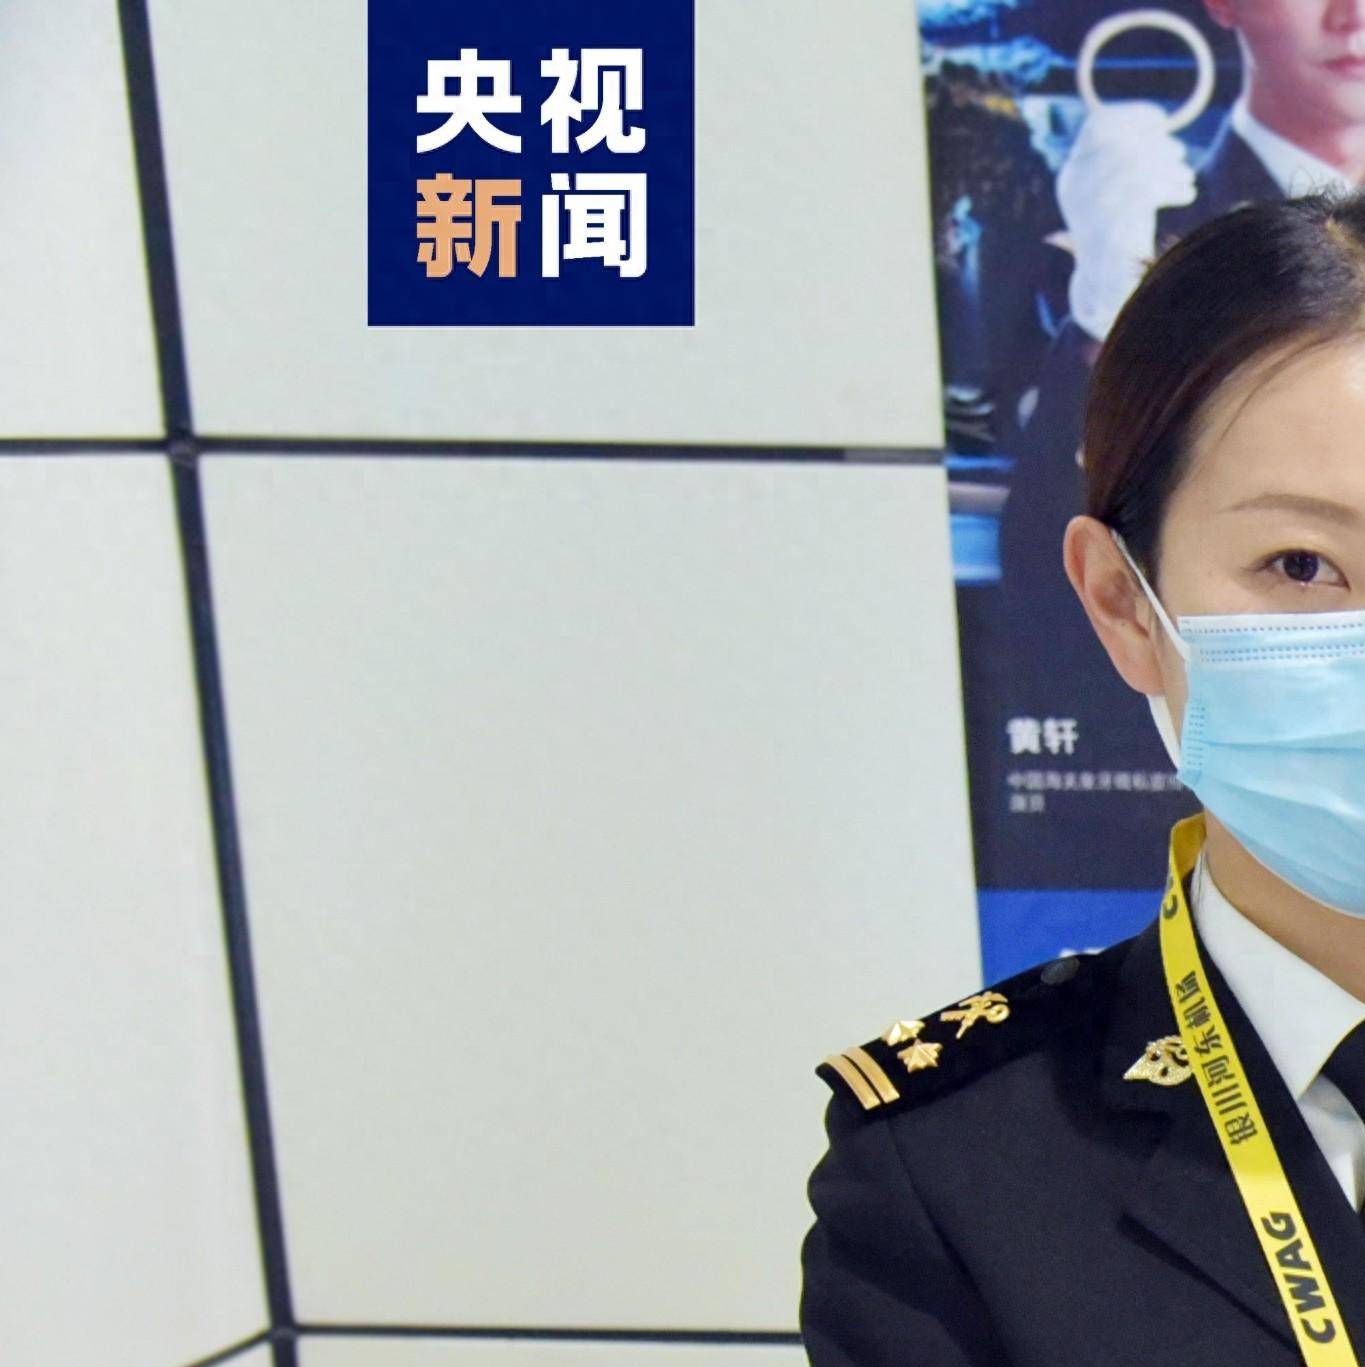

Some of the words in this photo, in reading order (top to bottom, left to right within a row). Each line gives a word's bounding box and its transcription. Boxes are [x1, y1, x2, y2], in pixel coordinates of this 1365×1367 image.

[1175, 970, 1259, 1145] 银川河东机场
[1260, 1210, 1337, 1344] CWAG
